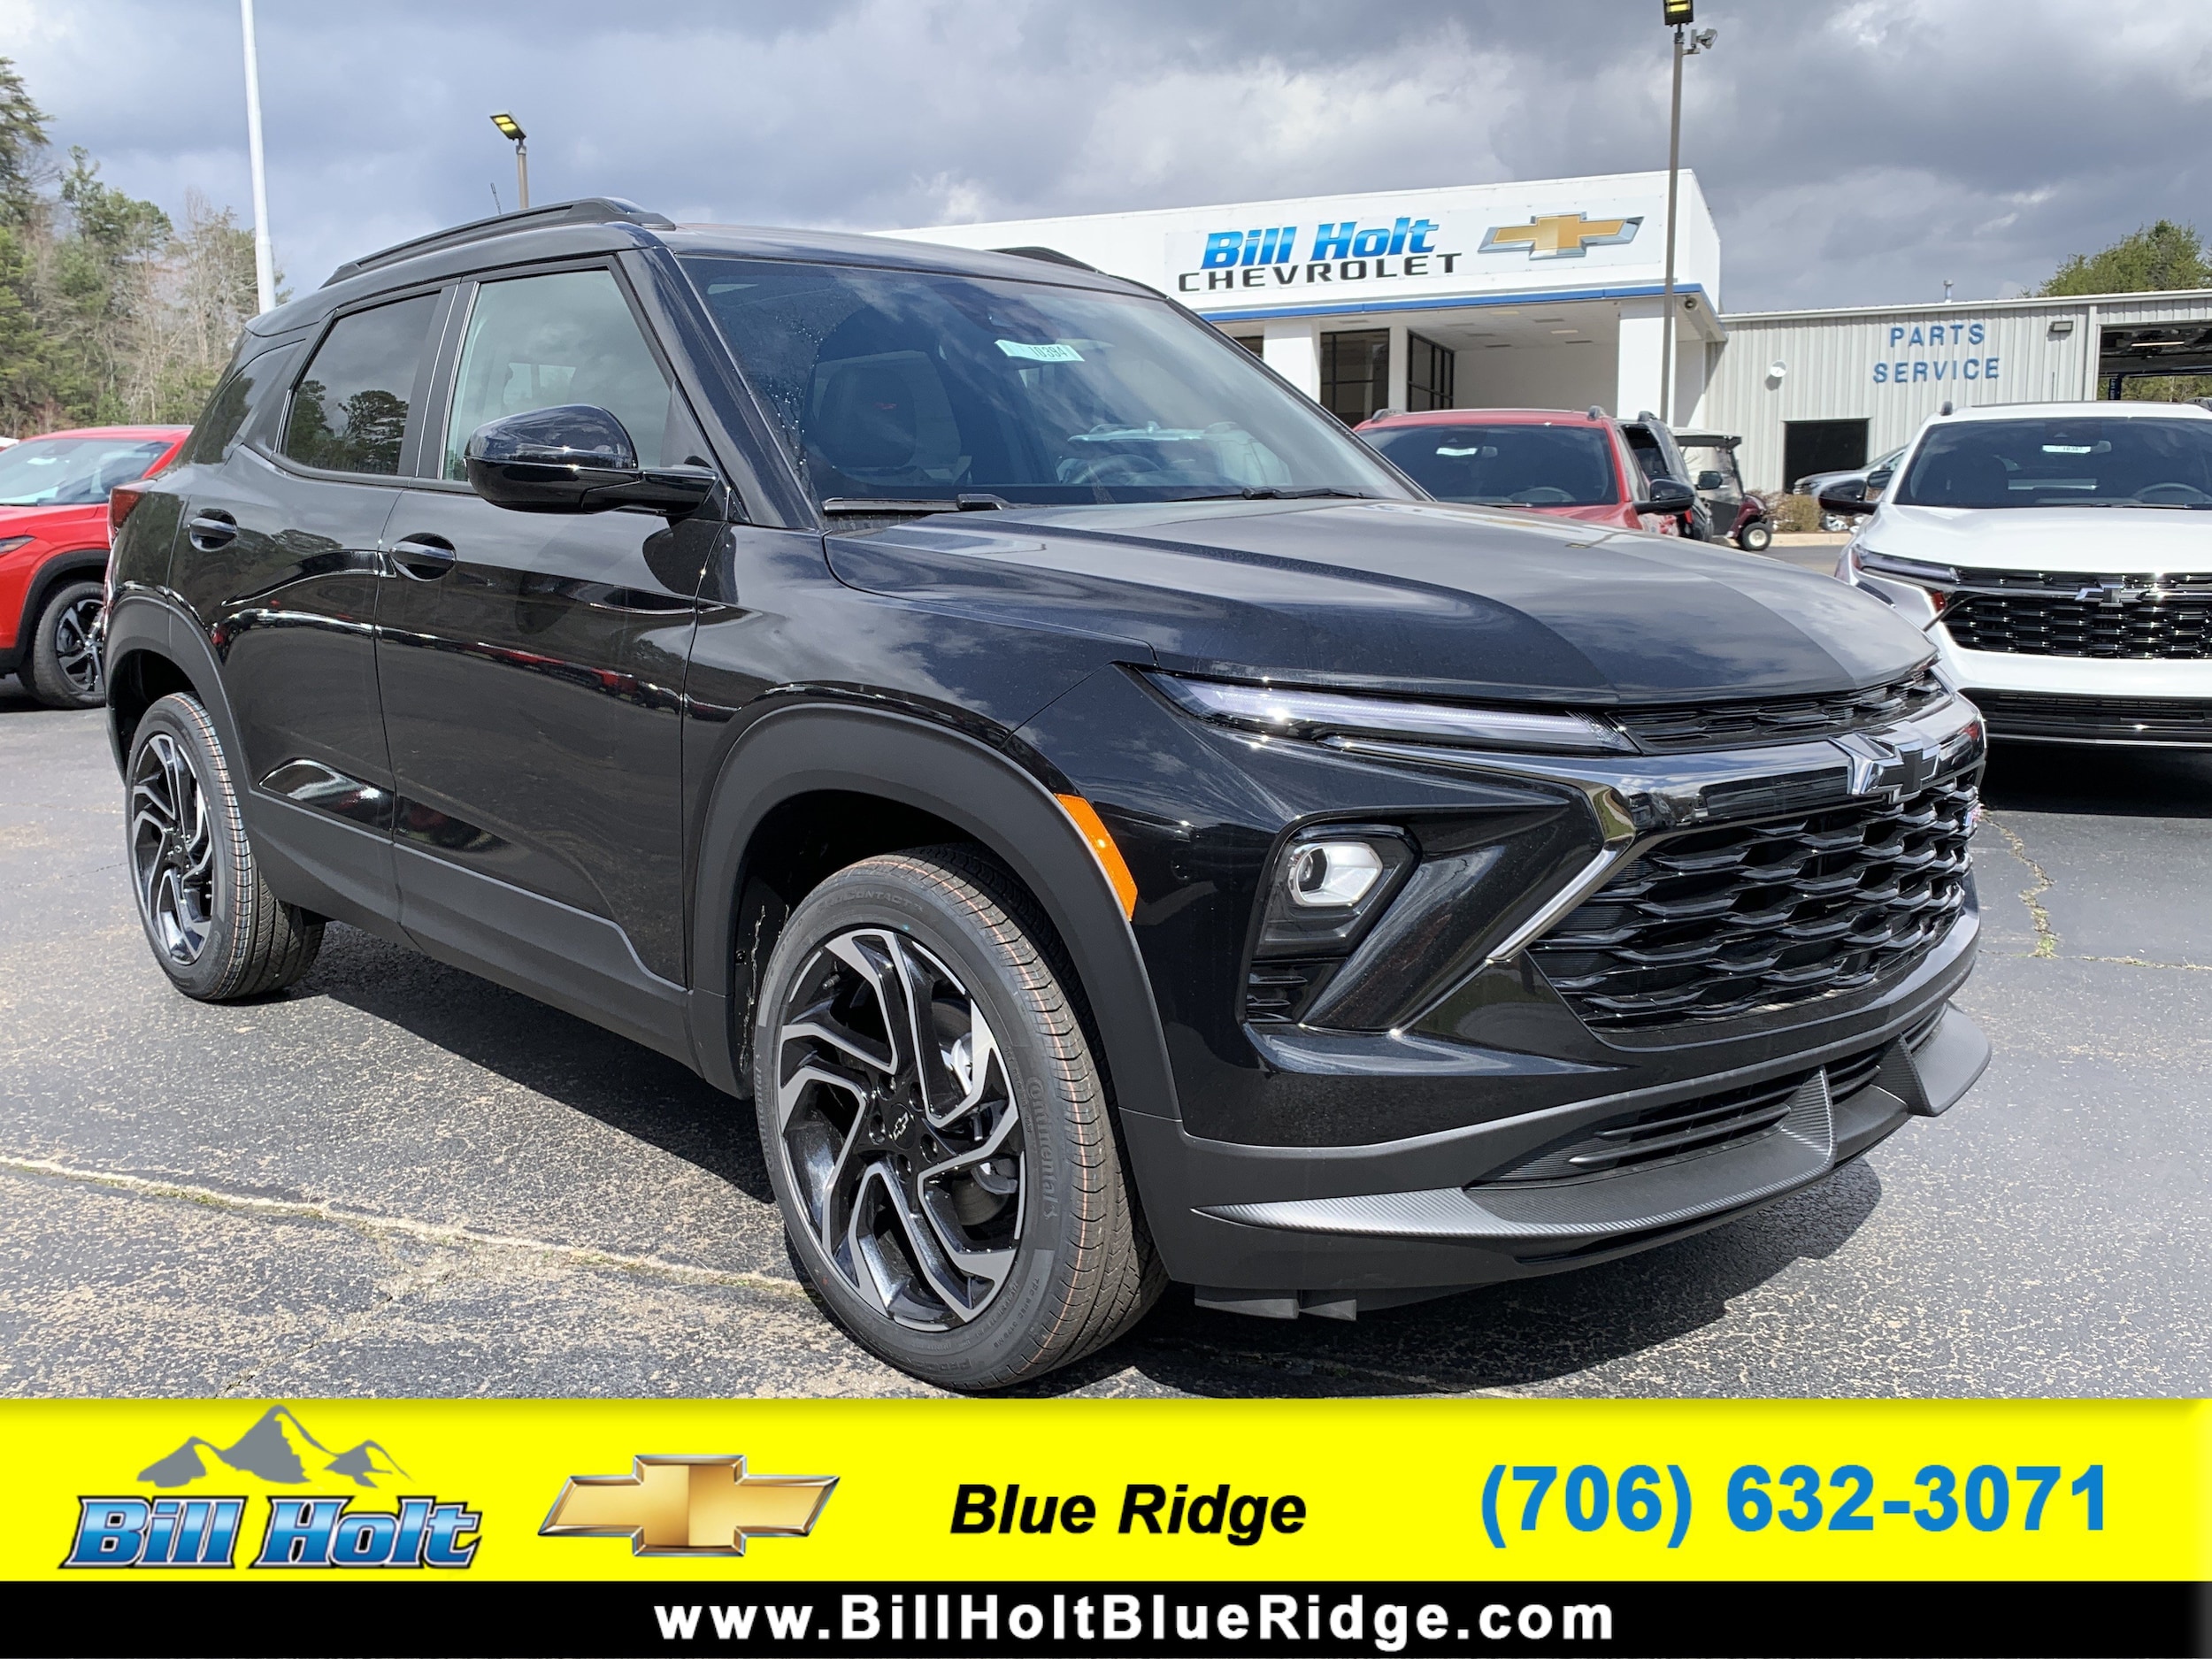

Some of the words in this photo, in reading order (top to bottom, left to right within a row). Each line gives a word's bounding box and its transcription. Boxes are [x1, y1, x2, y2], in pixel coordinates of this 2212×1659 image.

[1200, 226, 1297, 270] Bill
[1310, 216, 1440, 258] Holt
[1178, 253, 1463, 292] CHEVROLET
[1890, 323, 1985, 347] PARTS
[1027, 345, 1070, 358] 10394
[1873, 357, 2001, 383] SERVICE
[1025, 1075, 1059, 1204] Continental
